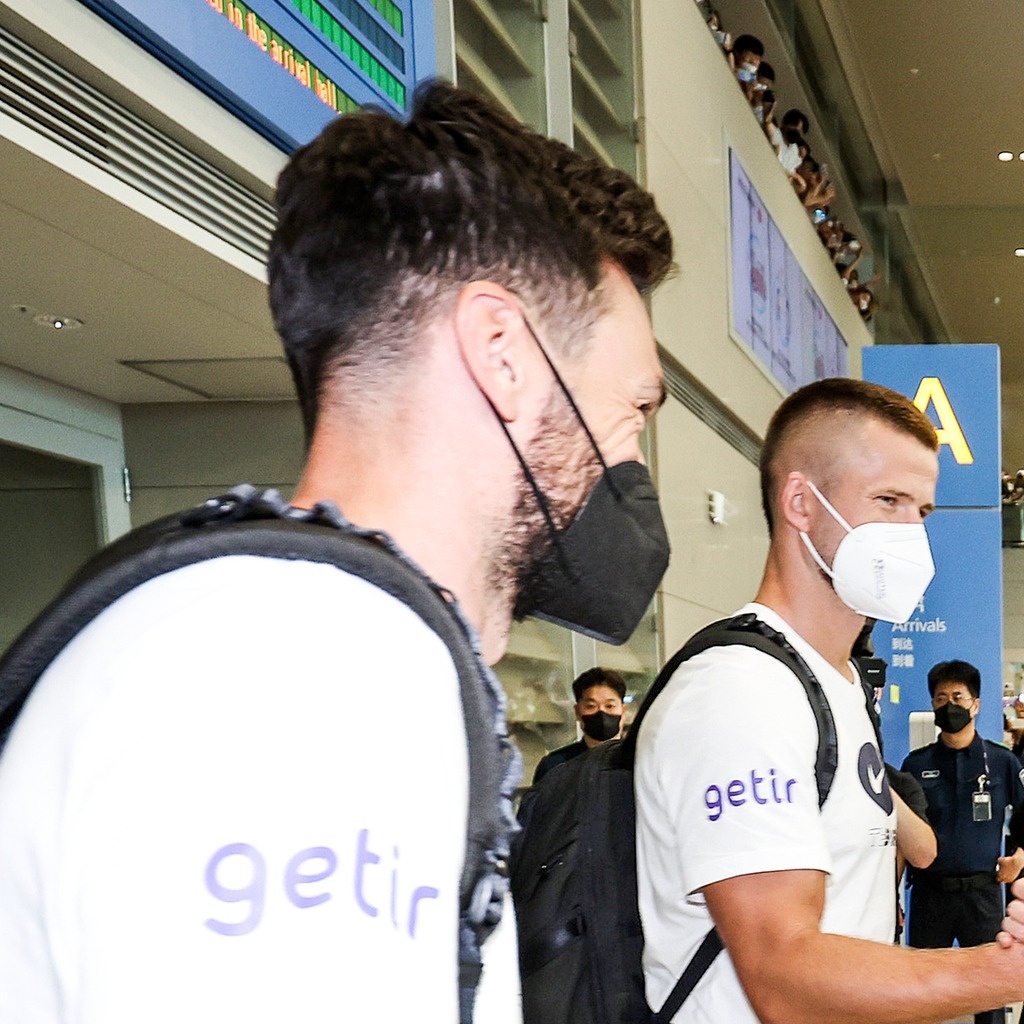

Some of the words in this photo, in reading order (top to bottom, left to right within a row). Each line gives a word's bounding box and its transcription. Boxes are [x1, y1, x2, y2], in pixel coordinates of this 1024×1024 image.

[227, 2, 243, 30] in
[246, 12, 267, 51] the
[269, 39, 311, 88] arrival
[913, 376, 975, 465] A
[891, 617, 947, 632] Arrivals
[704, 768, 797, 822] getir
[204, 828, 440, 940] getir
